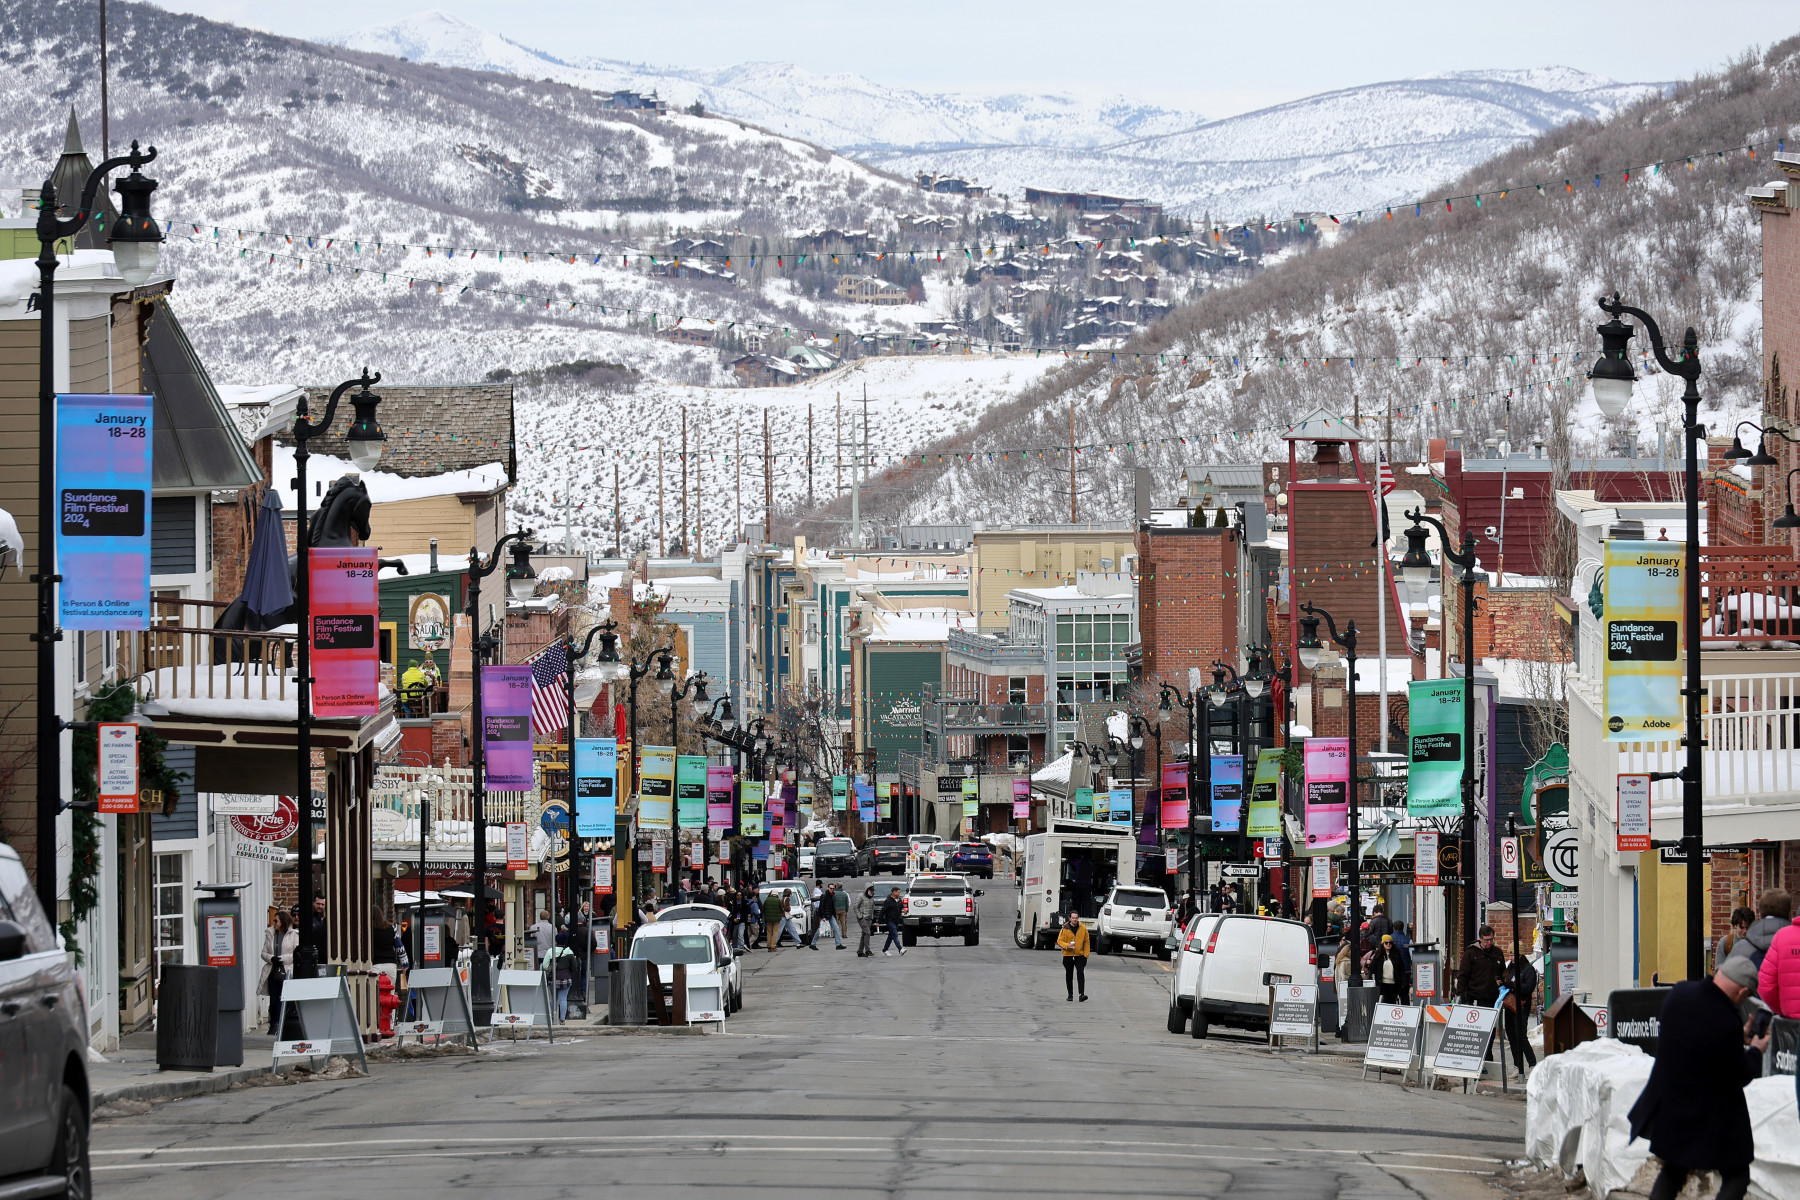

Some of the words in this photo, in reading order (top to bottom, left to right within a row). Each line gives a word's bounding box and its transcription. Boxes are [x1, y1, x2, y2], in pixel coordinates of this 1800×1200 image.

[95, 413, 146, 426] January
[64, 492, 117, 502] Sundance
[64, 503, 86, 512] Film
[89, 503, 129, 512] Festival
[64, 514, 90, 528] 2024
[337, 560, 374, 570] January
[1636, 556, 1680, 567] January
[1611, 624, 1654, 632] Sundance
[316, 633, 334, 643] 2024
[1611, 633, 1629, 641] Film
[1631, 633, 1664, 641] Festival
[1611, 642, 1632, 654] 2024
[487, 729, 500, 737] 2024
[225, 795, 262, 804] SAUNDERS
[230, 816, 254, 838] OURMET
[237, 842, 269, 854] GELATO
[236, 850, 268, 860] ESPRESSO
[1362, 861, 1415, 871] LANAG
[443, 870, 472, 878] Jewelry
[1617, 1018, 1649, 1037] sundance
